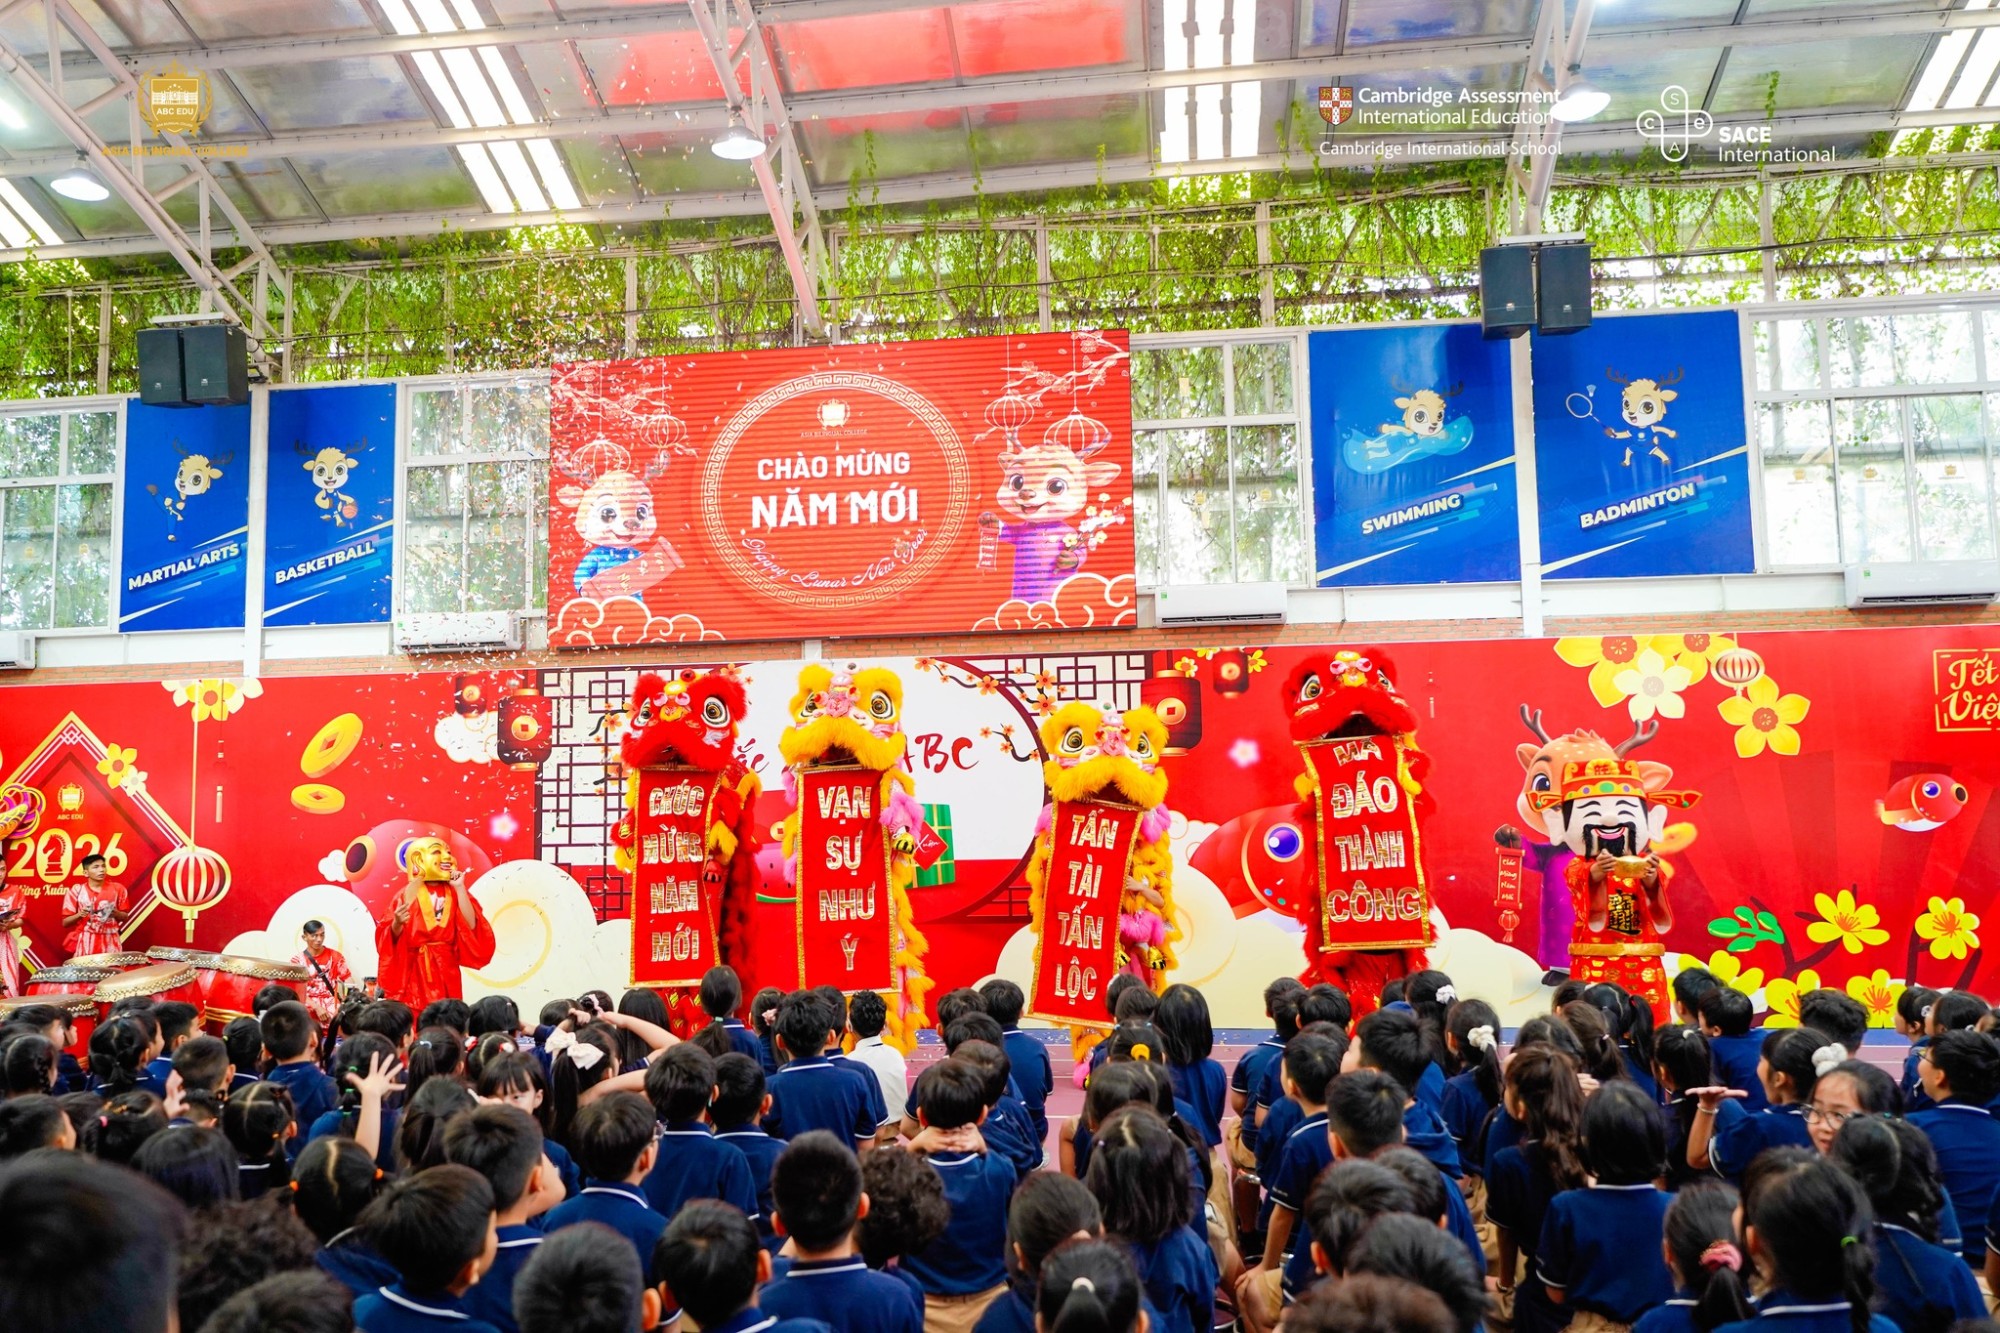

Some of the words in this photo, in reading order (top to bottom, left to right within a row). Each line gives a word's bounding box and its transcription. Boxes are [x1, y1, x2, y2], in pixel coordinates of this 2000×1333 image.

[757, 452, 828, 480] CHÀO
[835, 448, 911, 477] MỪNG
[751, 487, 837, 528] NĂM
[850, 482, 918, 524] MỚI
[1362, 493, 1461, 535] SWIMMING
[1580, 482, 1696, 528] BADMINTON
[128, 558, 196, 590] MARTIAL
[199, 543, 240, 567] ARTS
[275, 541, 375, 584] BASKETBALL
[741, 538, 790, 579] Happy
[791, 571, 847, 588] Lunar
[852, 557, 896, 585] New
[893, 528, 928, 565] Year
[1948, 652, 1999, 690] Tết
[648, 779, 705, 817] CHÚC
[817, 785, 872, 825] VẠN
[1331, 770, 1398, 819] ĐÁO
[642, 824, 704, 864] MỪNG
[1069, 808, 1119, 850] TẤN
[1334, 824, 1405, 872] THÀNH
[7, 828, 128, 884] 2026
[825, 830, 864, 876] SỰ
[650, 876, 699, 915] NĂM
[1068, 853, 1103, 899] TÀI
[818, 881, 876, 922] NHƯ
[1327, 880, 1422, 922] CÔNG
[651, 922, 700, 962] MỚI
[1057, 901, 1104, 950] TẤN
[840, 933, 860, 971] Ý
[1054, 956, 1097, 1005] LỘC
